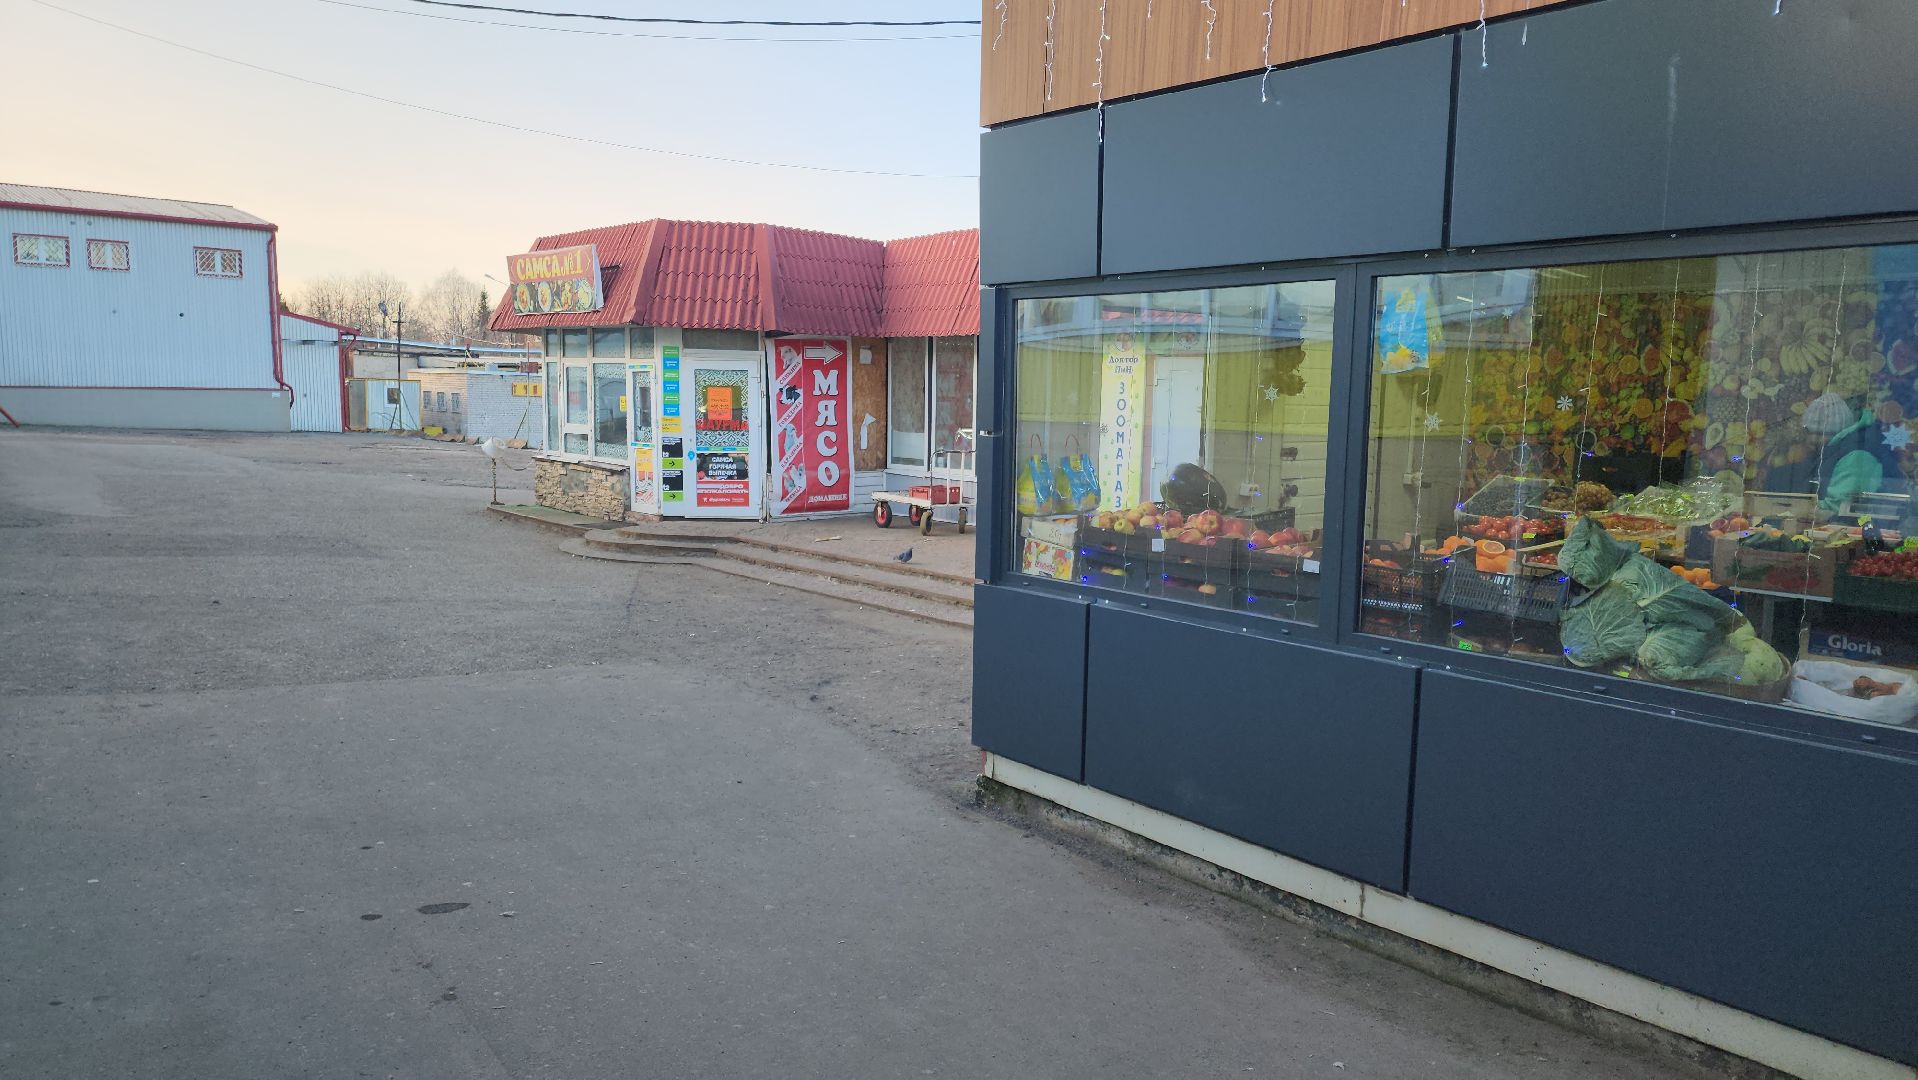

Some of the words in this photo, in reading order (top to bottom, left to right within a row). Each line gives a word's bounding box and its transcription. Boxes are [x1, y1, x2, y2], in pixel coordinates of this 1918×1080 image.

[516, 254, 560, 280] САМСА
[812, 369, 840, 487] МЯСО
[1828, 634, 1882, 656] Gloria
